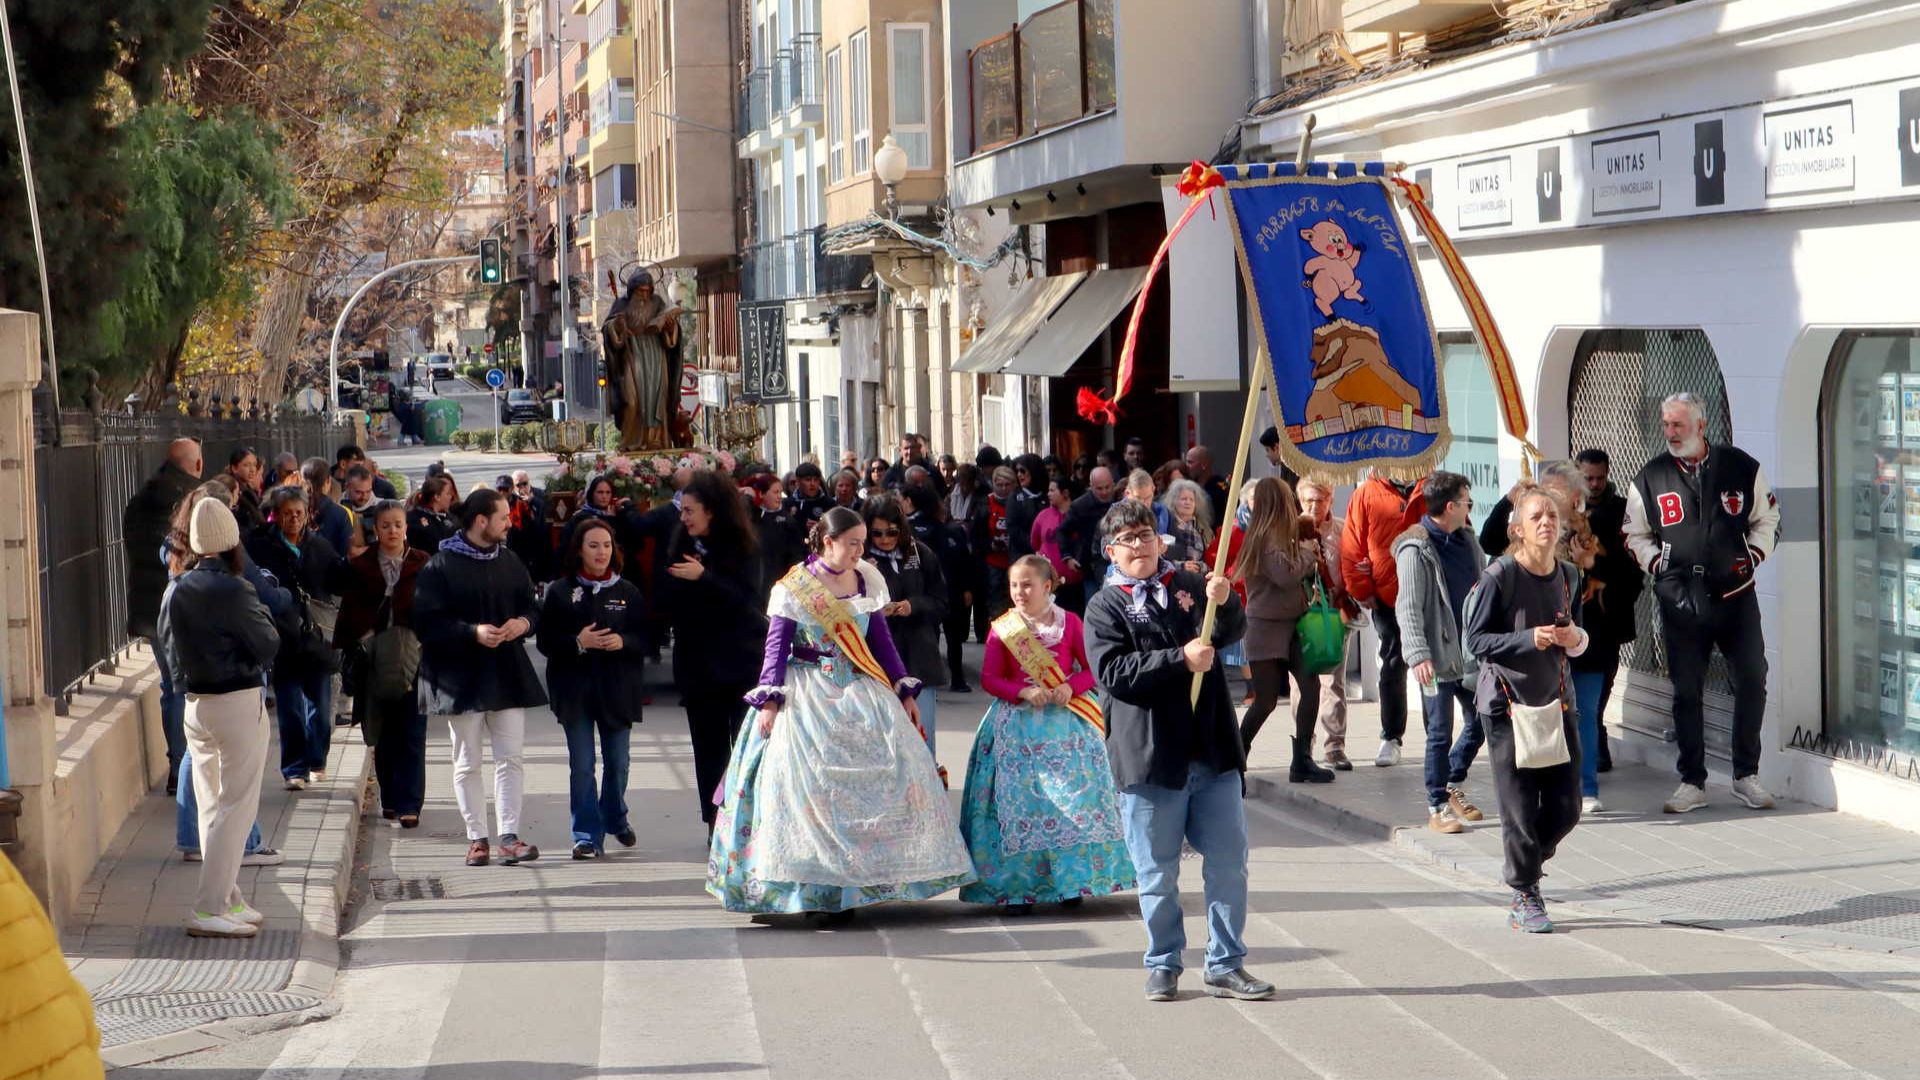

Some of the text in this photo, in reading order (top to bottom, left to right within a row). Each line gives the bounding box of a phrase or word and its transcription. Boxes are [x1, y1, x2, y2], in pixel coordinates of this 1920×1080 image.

[1784, 125, 1834, 151] UNITAS
[1910, 118, 1920, 154] U
[1607, 153, 1645, 175] UNITAS
[1703, 148, 1714, 179] U
[1469, 174, 1500, 194] UNITAS
[1543, 171, 1552, 198] U
[749, 310, 758, 377] LA PLAZA
[764, 321, 772, 363] REINA
[1657, 492, 1684, 527] B
